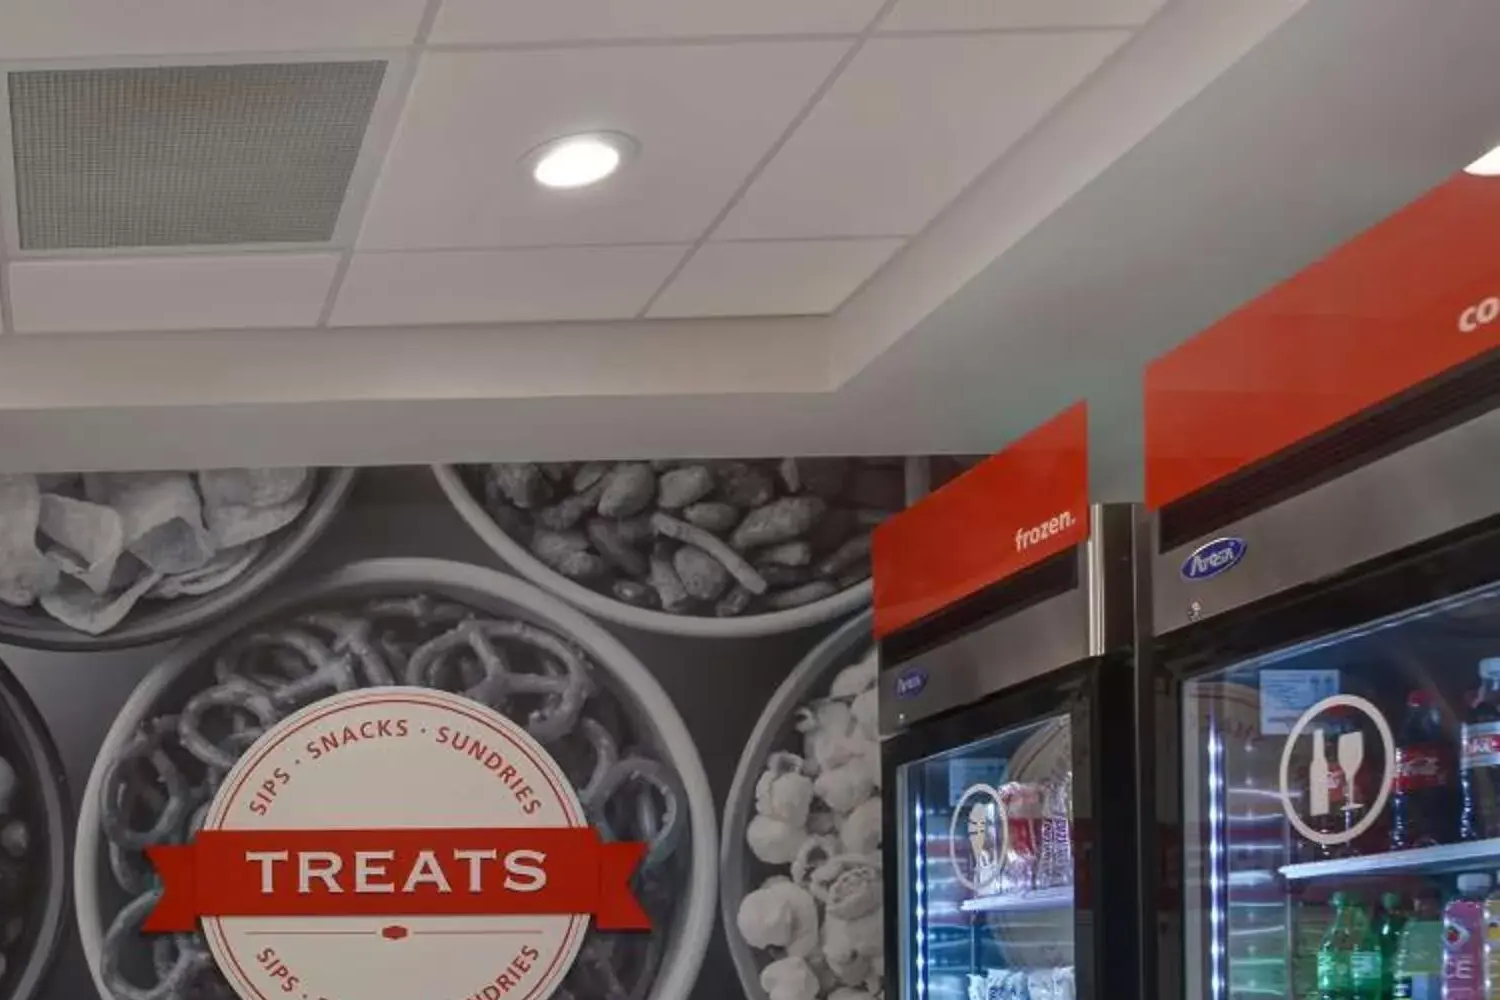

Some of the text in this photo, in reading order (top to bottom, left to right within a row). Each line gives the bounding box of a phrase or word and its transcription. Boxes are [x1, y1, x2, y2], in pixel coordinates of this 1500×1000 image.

[1015, 510, 1076, 553] frozen.
[249, 718, 542, 816] SIPS SNACKS SUNDRIES
[245, 848, 549, 895] TREATS
[255, 947, 300, 993] SIPS
